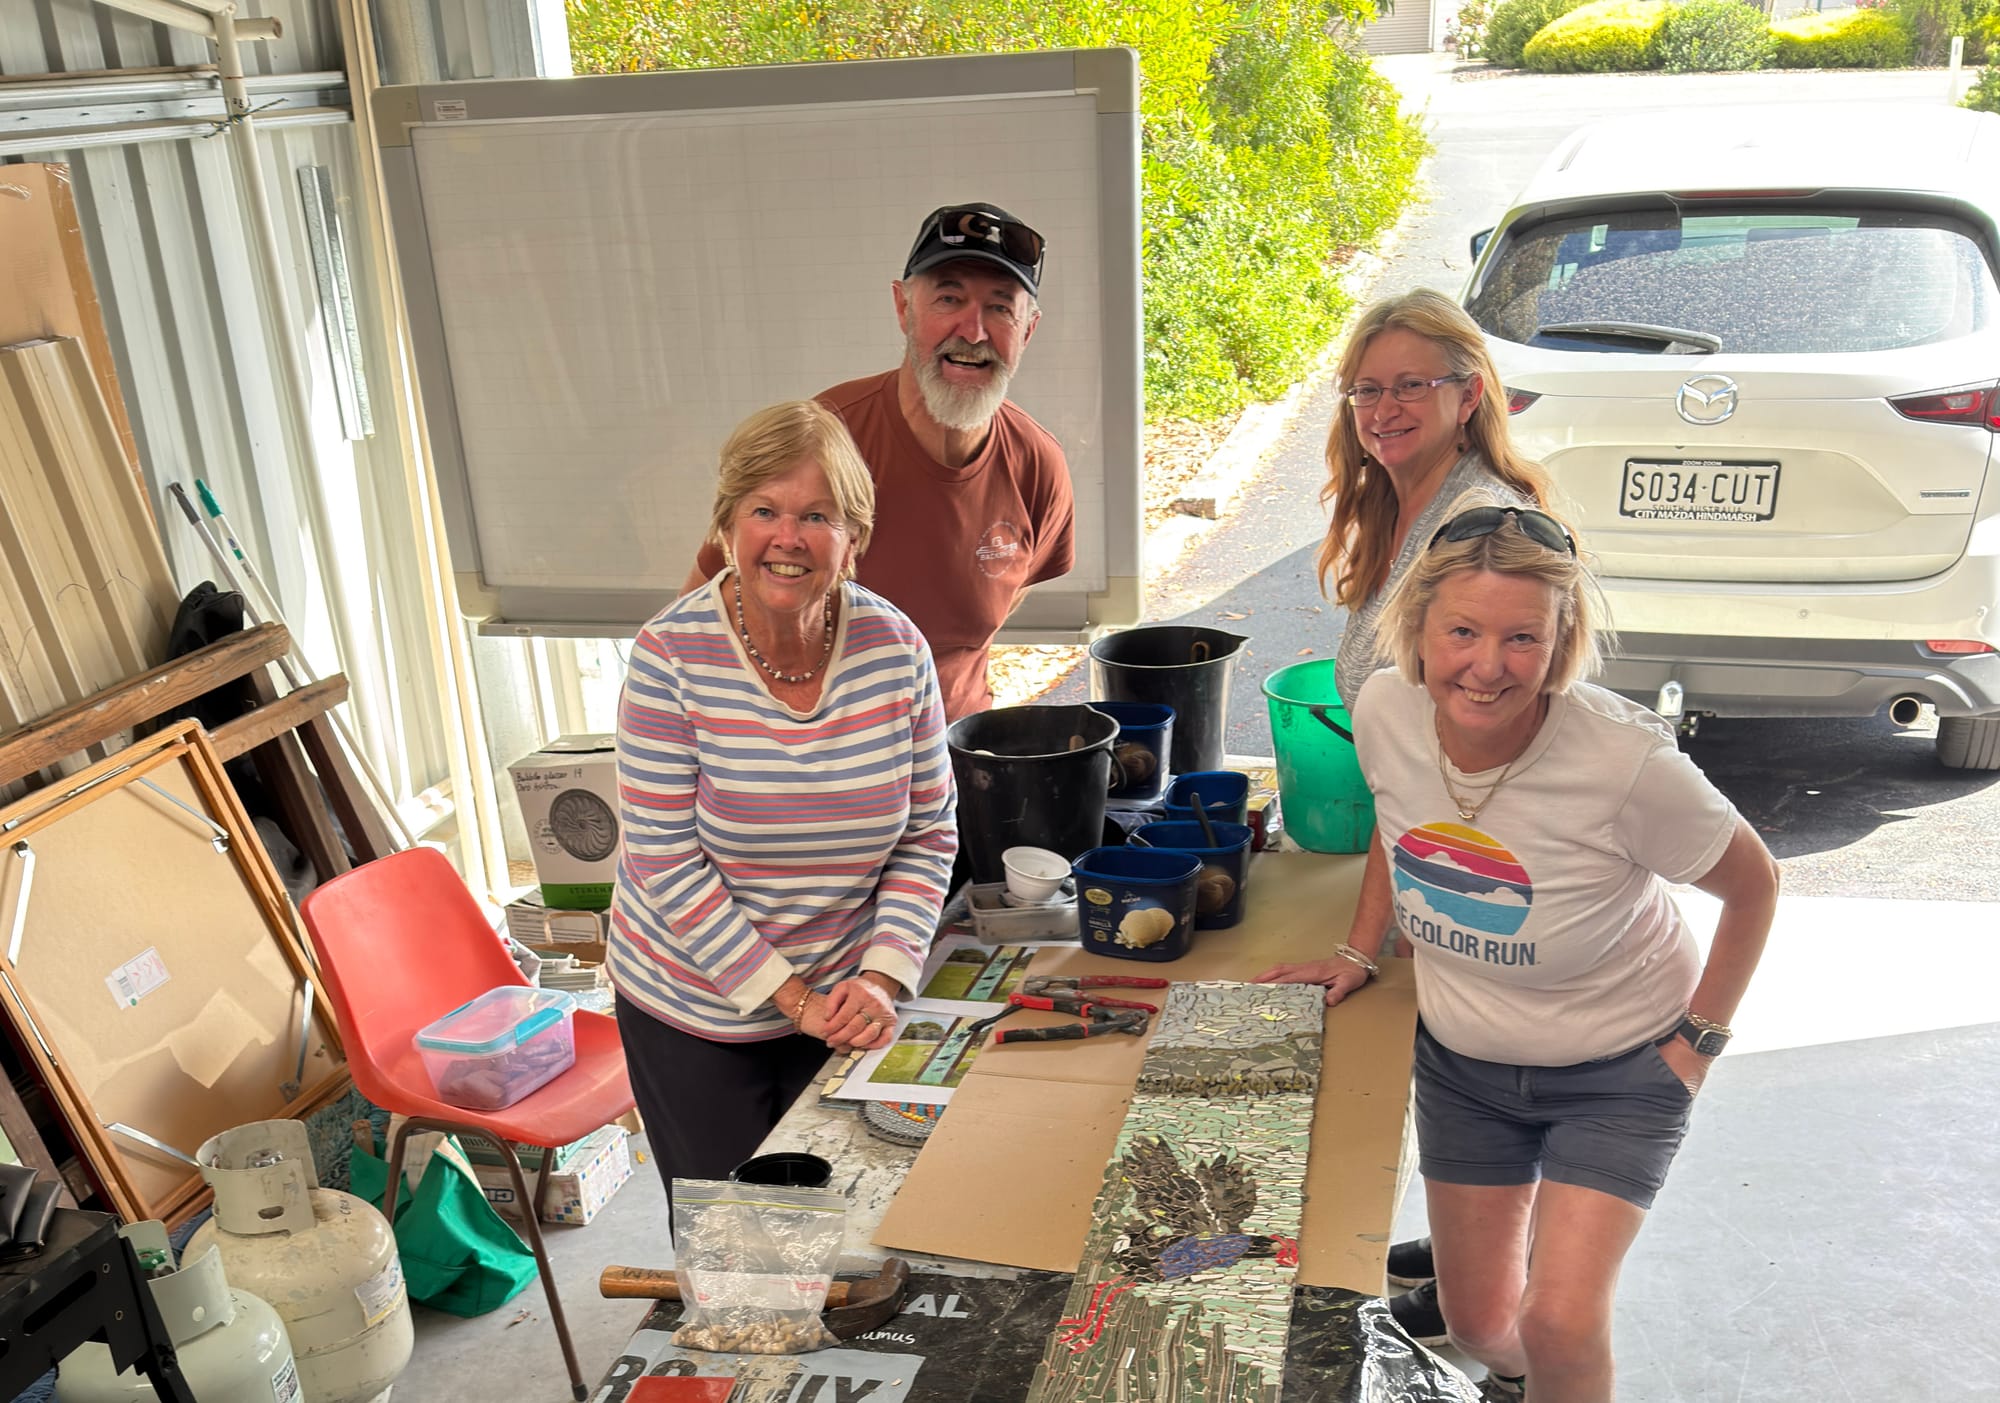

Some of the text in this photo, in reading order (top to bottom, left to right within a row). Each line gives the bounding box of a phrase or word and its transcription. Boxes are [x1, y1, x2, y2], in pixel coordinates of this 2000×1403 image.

[1634, 510, 1758, 522] CITY MAZDA HINDMARSH
[1410, 914, 1480, 959] COLOR
[1484, 939, 1537, 967] RUN
